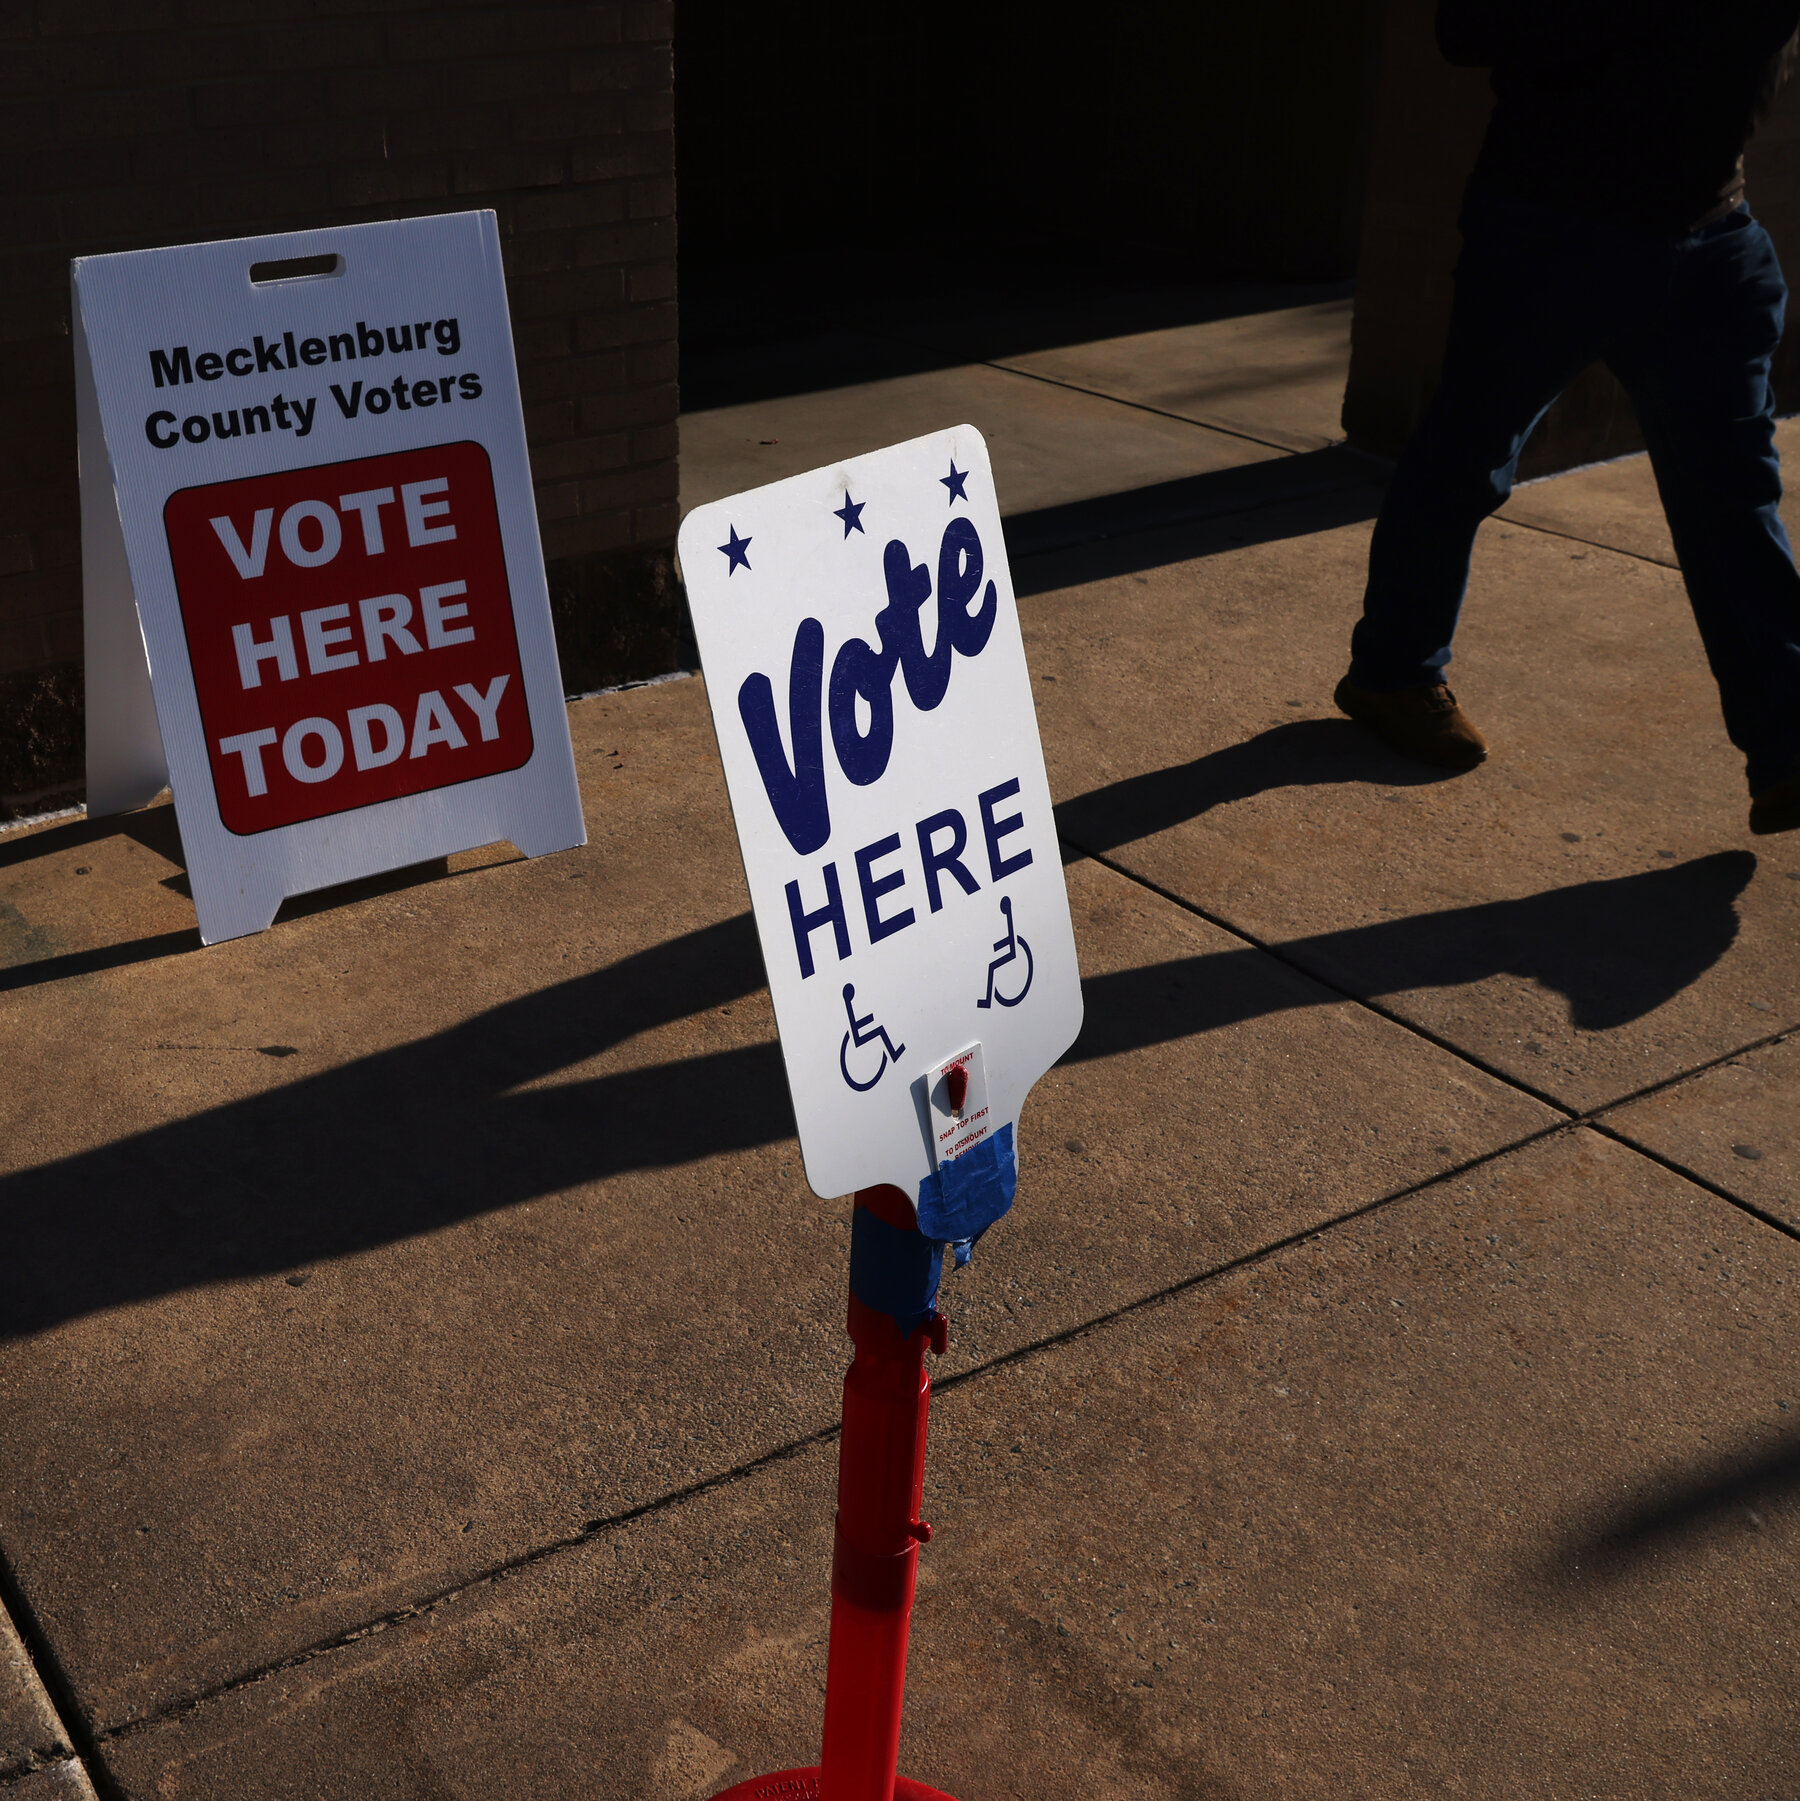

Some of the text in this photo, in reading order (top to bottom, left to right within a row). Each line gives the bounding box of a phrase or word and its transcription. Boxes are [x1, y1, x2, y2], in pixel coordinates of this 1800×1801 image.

[149, 318, 461, 389] Mecklenburg
[145, 372, 483, 449] County Voters
[210, 477, 456, 579] VOTE
[232, 580, 475, 690] HERE
[738, 517, 997, 856] Vote
[219, 674, 510, 797] TODAY
[785, 777, 1033, 980] HERE
[949, 1051, 974, 1071] MOUNT
[939, 1106, 989, 1142] SNAP TOP FIRST
[945, 1126, 988, 1157] TO DISMOUNT
[754, 1778, 807, 1799] PATENT
